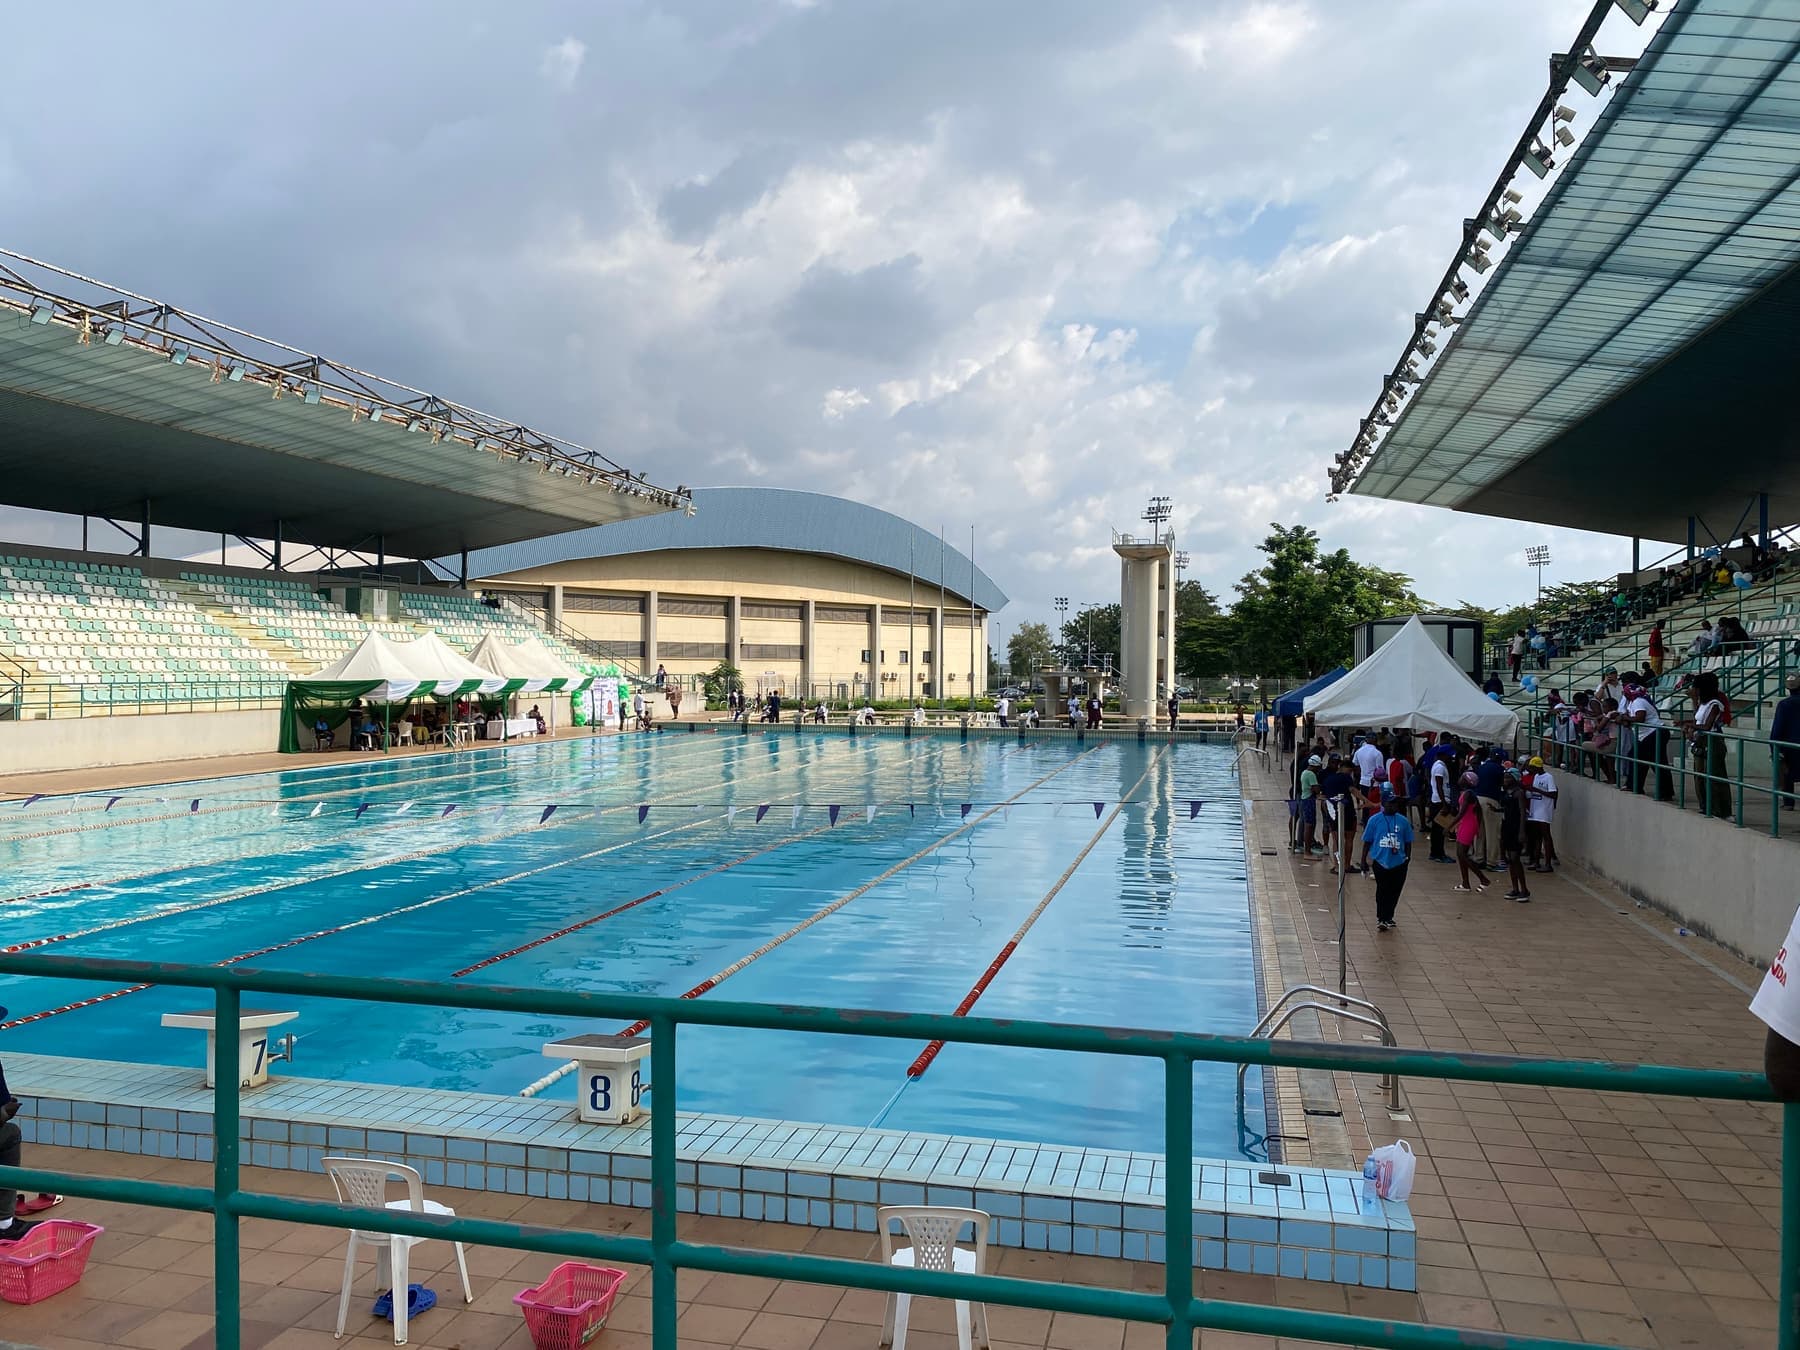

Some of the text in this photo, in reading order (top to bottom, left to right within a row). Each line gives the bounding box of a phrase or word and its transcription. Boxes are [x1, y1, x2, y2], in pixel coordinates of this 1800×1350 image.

[252, 1039, 267, 1075] 7
[590, 1075, 611, 1111] 8
[631, 1070, 640, 1107] 8
